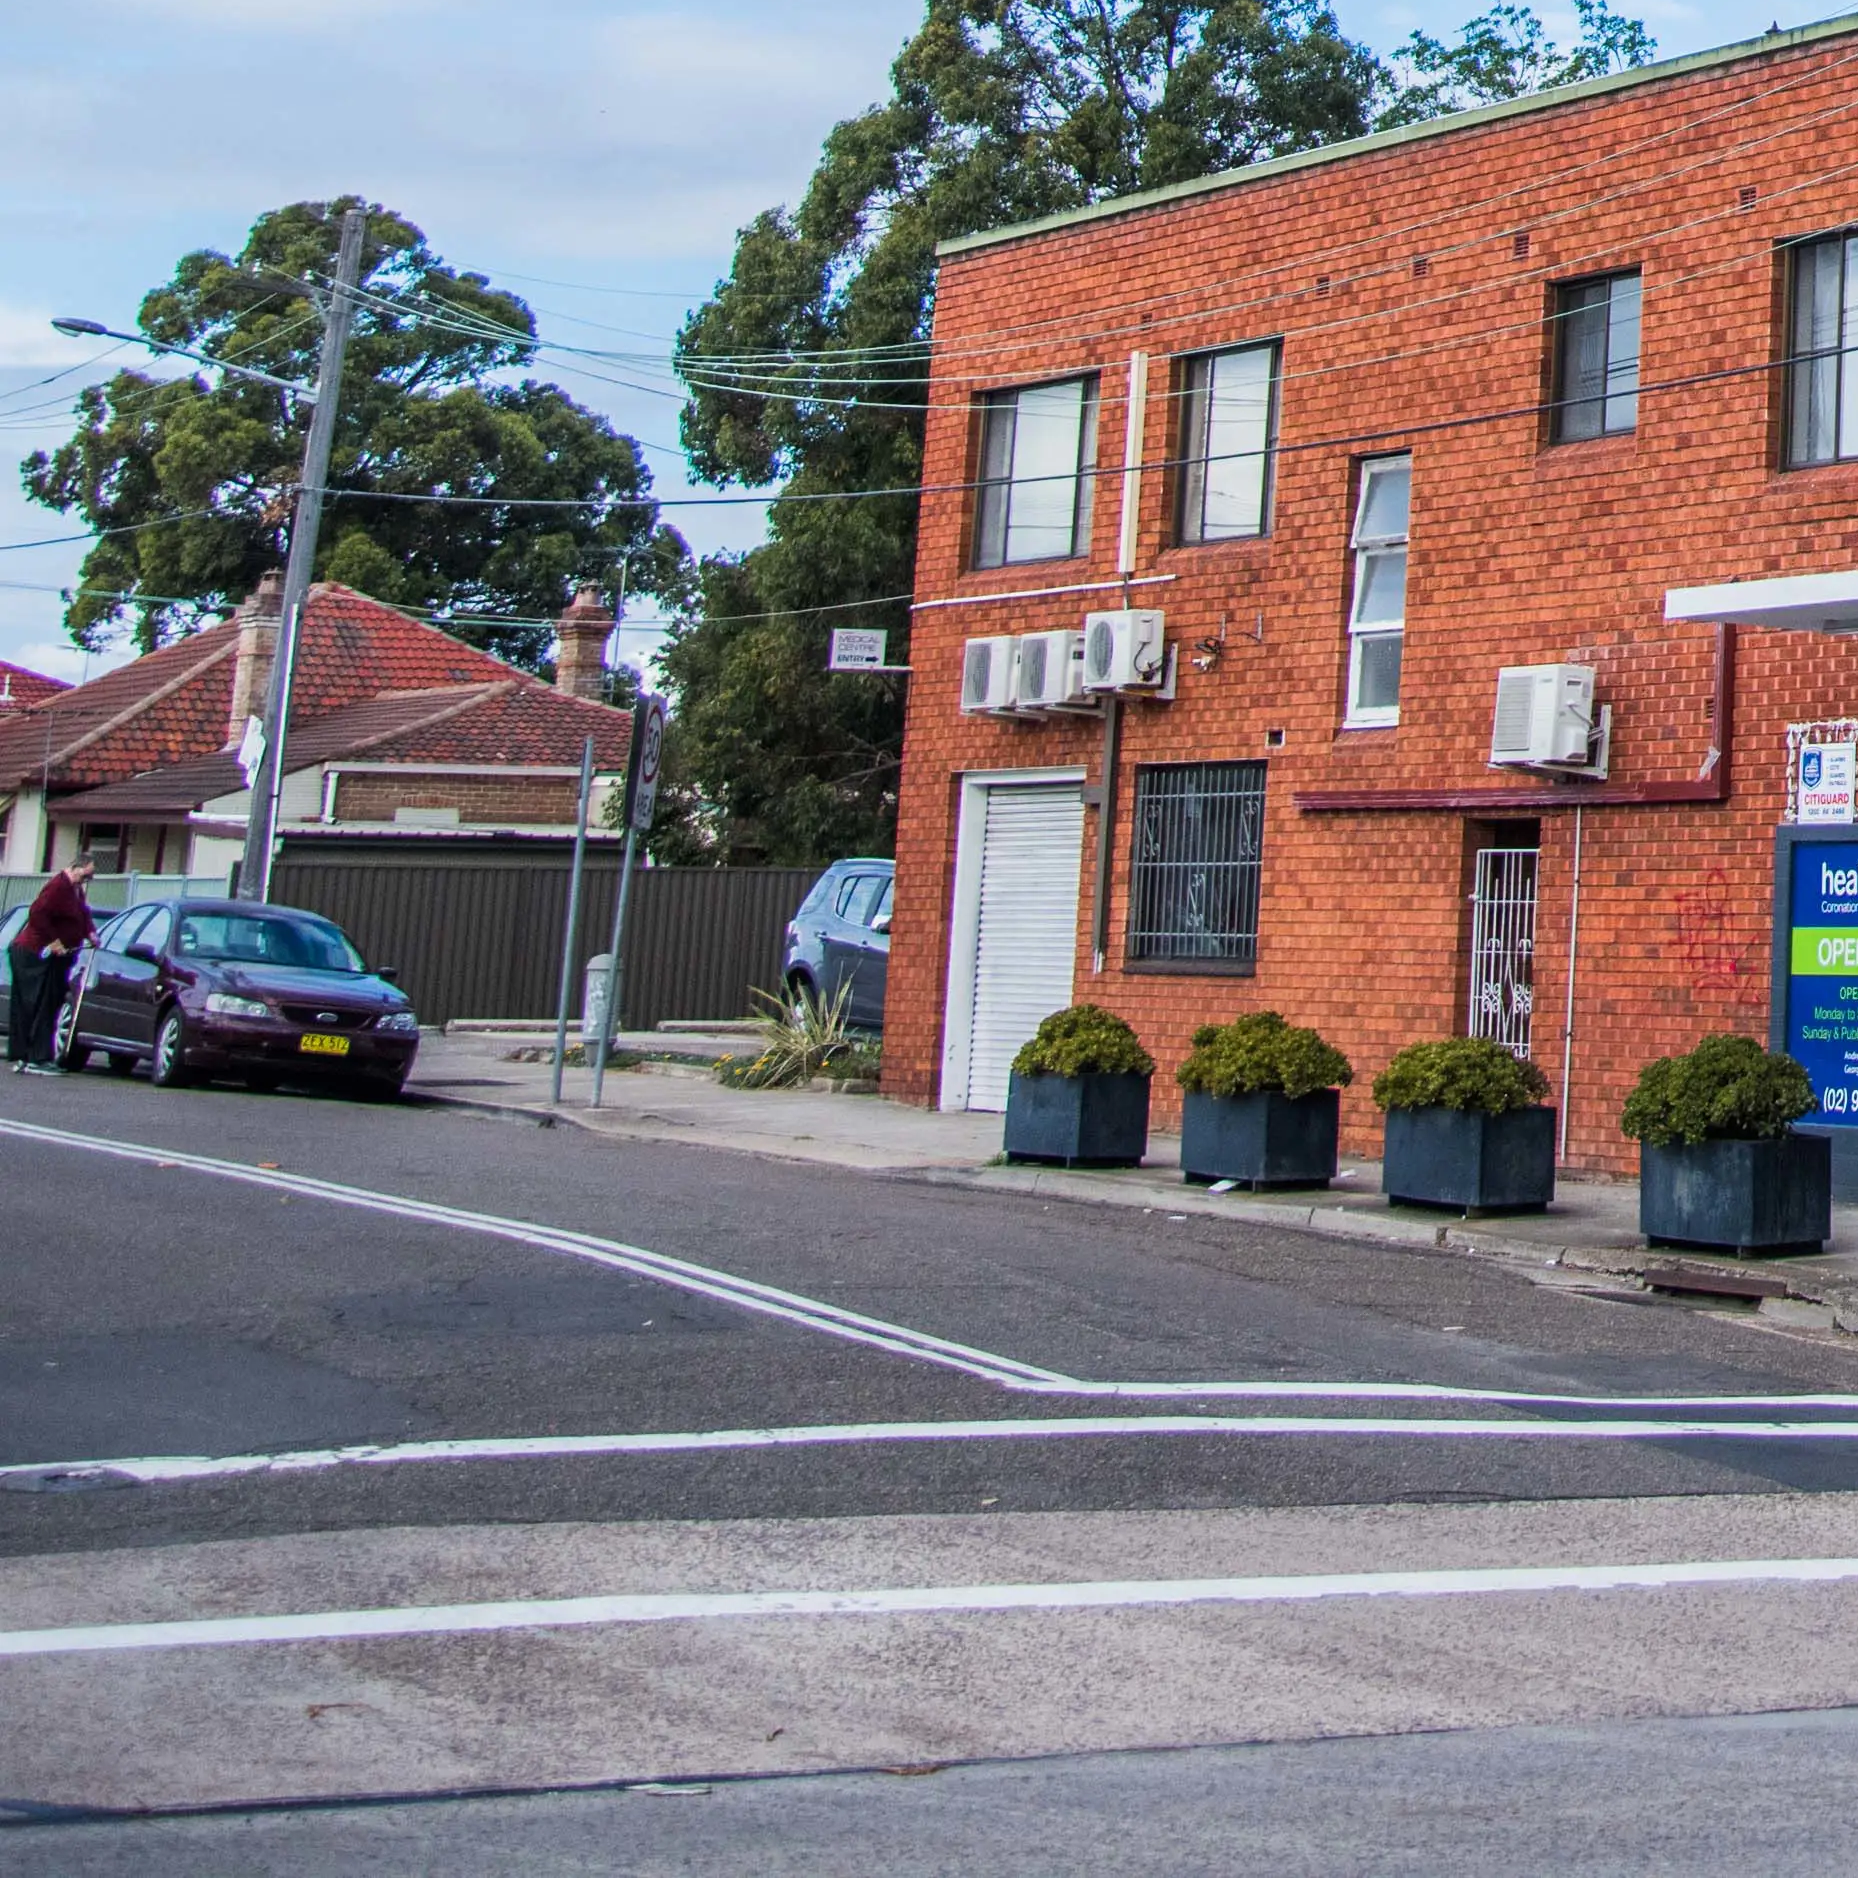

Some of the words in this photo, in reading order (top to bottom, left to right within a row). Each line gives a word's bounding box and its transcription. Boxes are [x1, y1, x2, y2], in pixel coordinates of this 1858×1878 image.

[1804, 793, 1850, 805] CITIGUARD
[1814, 1007, 1845, 1024] Monday
[1847, 1008, 1855, 1021] to
[1802, 1025, 1832, 1043] Sunday
[1823, 1086, 1848, 1114] (02)
